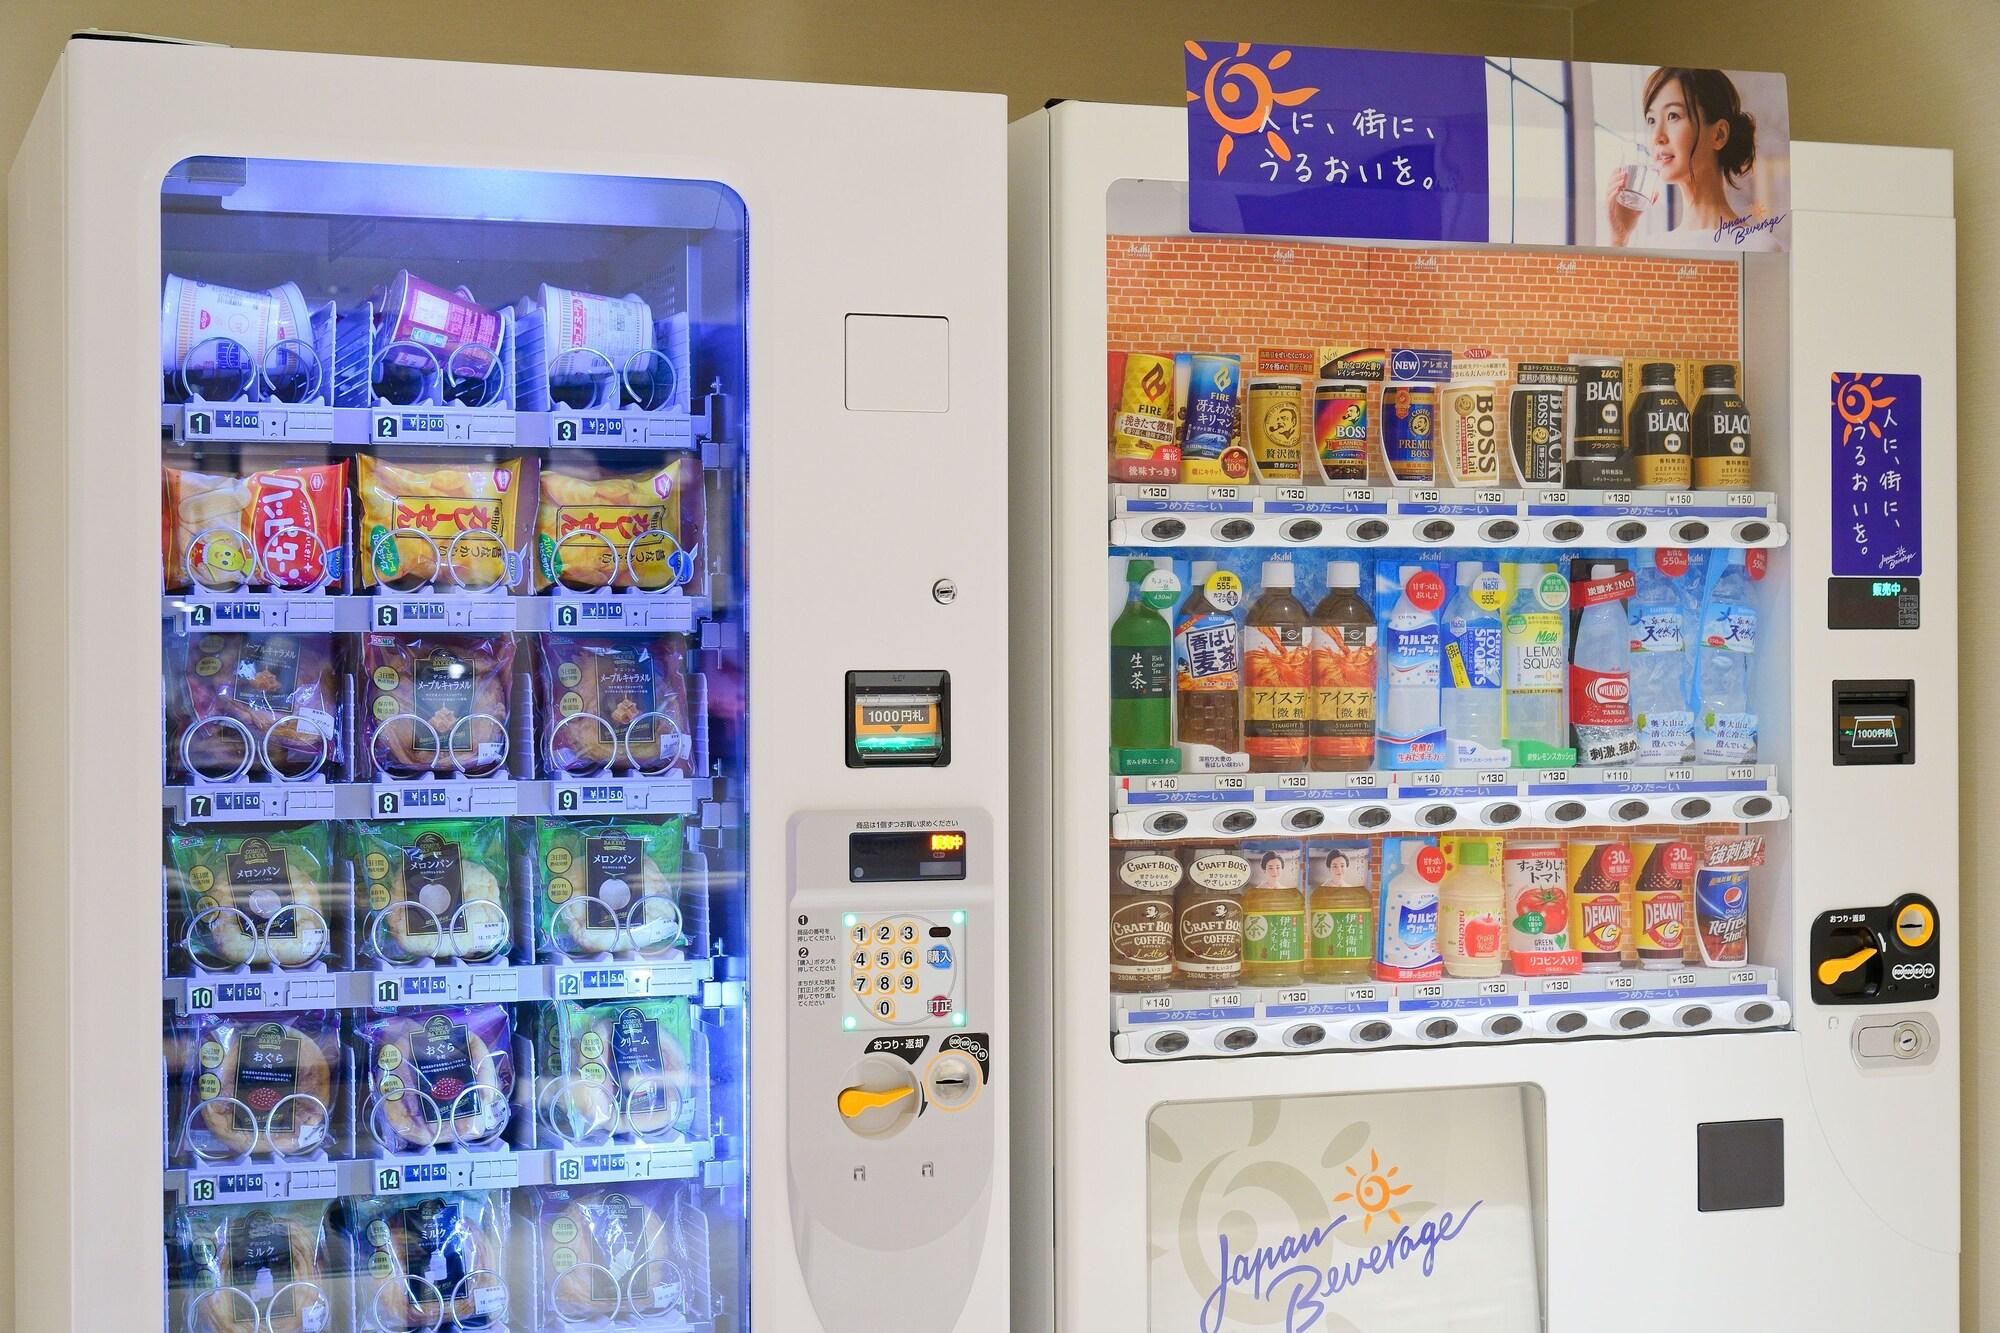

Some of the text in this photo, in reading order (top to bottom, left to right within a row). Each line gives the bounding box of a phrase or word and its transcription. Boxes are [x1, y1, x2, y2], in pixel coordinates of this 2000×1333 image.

[1258, 106, 1436, 141] 人に、街に、
[1260, 151, 1435, 190] うるおいを。
[1714, 215, 1752, 243] Japan
[1731, 213, 1787, 245] Beverage
[1395, 362, 1417, 370] NEW
[1210, 392, 1229, 401] FIRE
[1138, 405, 1161, 415] FIRE
[1538, 394, 1548, 426] BOSS
[195, 416, 203, 432] 1
[224, 414, 258, 425] ¥200
[410, 418, 443, 429] ¥200
[382, 419, 392, 435] 2
[562, 423, 572, 439] 3
[589, 420, 621, 431] ¥200
[1336, 426, 1366, 438] BOSS
[1477, 394, 1496, 473] BOSS
[1128, 466, 1176, 477] 後味すっきり
[1880, 409, 1901, 527] 人に、街に、
[1852, 418, 1868, 554] うるおいを。
[1143, 488, 1167, 497] ¥130
[1212, 489, 1236, 498] ¥130
[1281, 490, 1304, 498] ¥130
[1347, 490, 1371, 499] ¥130
[1414, 491, 1437, 500] ¥130
[1478, 493, 1501, 501] ¥130
[1543, 493, 1565, 502] ¥130
[1608, 494, 1630, 502] ¥130
[1670, 495, 1691, 504] ¥150
[1731, 495, 1752, 504] ¥150
[259, 475, 300, 587] ハッピーターン
[1663, 557, 1686, 566] 550ml
[1873, 582, 1900, 596] 販売中
[224, 604, 259, 614] ¥110
[411, 605, 443, 614] ¥110
[590, 605, 621, 615] ¥110
[195, 608, 204, 624] 4
[382, 608, 392, 624] 5
[562, 608, 571, 623] 6
[1641, 626, 1682, 641] 天然水
[1398, 634, 1439, 645] カルピス
[1193, 646, 1235, 675] 麦茶
[1475, 629, 1486, 686] SPORTS
[1129, 652, 1148, 690] 生茶
[601, 673, 651, 682] メープルキャラメル
[418, 681, 471, 690] メープルキャラメル
[868, 710, 924, 722] 1000円札
[1590, 740, 1640, 761] 刺激、強め。
[1417, 774, 1440, 784] ¥140
[1481, 774, 1504, 782] ¥130
[1543, 771, 1565, 780] ¥130
[1607, 771, 1628, 780] ¥110
[1669, 770, 1690, 779] ¥110
[1731, 769, 1752, 778] ¥110
[1149, 780, 1175, 788] ¥140
[1218, 778, 1243, 787] ¥130
[1282, 778, 1306, 786] ¥130
[1351, 776, 1373, 784] ¥130
[412, 792, 445, 802] ¥150
[563, 792, 572, 807] 9
[591, 790, 622, 799] ¥150
[224, 796, 259, 805] ¥150
[384, 796, 393, 811] 8
[196, 799, 206, 814] 7
[856, 820, 958, 829] 商品は1個ずつお買い求めください
[1709, 837, 1762, 866] 強刺激!
[410, 859, 454, 870] メロンパン
[593, 855, 636, 864] メロンパン
[1127, 861, 1179, 873] CRAFT BOSS
[1196, 860, 1248, 872] CRAFT BOSS
[237, 866, 280, 879] メロンパン
[1530, 872, 1561, 883] トマト
[1134, 880, 1173, 888] やさしいコク
[1204, 879, 1241, 887] やさしいコク
[1314, 913, 1331, 935] 茶
[1830, 914, 1865, 923] おつり・返却
[1113, 921, 1154, 936] CRAFT
[1183, 920, 1225, 934] CRAFT
[1246, 916, 1265, 938] 茶
[857, 927, 863, 941] 1
[881, 927, 890, 939] 2
[904, 927, 913, 939] 3
[1270, 921, 1279, 951] いえもん
[1280, 916, 1291, 960] 伊右衛門
[1336, 919, 1345, 948] いえもん
[1346, 913, 1357, 956] 伊右衛門
[1134, 936, 1166, 946] COFFEE
[1203, 935, 1235, 944] COFFEE
[927, 950, 952, 963] 購入
[1134, 947, 1165, 959] Latte
[1203, 946, 1235, 957] Latte
[856, 953, 865, 965] 4
[880, 952, 889, 965] 5
[904, 952, 912, 964] 6
[591, 973, 623, 983] ¥150
[1672, 975, 1694, 984] ¥130
[1732, 972, 1754, 981] ¥130
[412, 980, 445, 988] ¥150
[560, 978, 575, 993] 12
[856, 978, 865, 991] 7
[881, 977, 889, 990] 8
[904, 976, 913, 989] 9
[1546, 981, 1569, 990] ¥130
[1609, 978, 1631, 988] ¥130
[226, 987, 260, 997] ¥150
[380, 984, 398, 999] 11
[1418, 987, 1440, 996] ¥130
[1483, 984, 1505, 993] ¥130
[193, 991, 211, 1006] 10
[1215, 995, 1238, 1004] ¥140
[1283, 992, 1306, 1001] ¥130
[1350, 990, 1373, 999] ¥130
[881, 1002, 889, 1015] 0
[927, 999, 952, 1013] 訂正
[1146, 998, 1170, 1008] ¥140
[620, 1036, 649, 1047] クリーム
[874, 1038, 924, 1050] おつり・返却
[426, 1043, 455, 1056] おぐら
[253, 1052, 284, 1064] おぐら
[592, 1158, 623, 1167] ¥150
[413, 1166, 445, 1176] ¥150
[561, 1162, 578, 1178] 15
[227, 1177, 261, 1187] ¥150
[380, 1172, 398, 1187] 14
[195, 1183, 212, 1198] 13
[420, 1228, 446, 1241] ミルク
[247, 1247, 275, 1258] ミルク
[1265, 1200, 1483, 1333] Beverage
[1200, 1214, 1348, 1333] Japan
